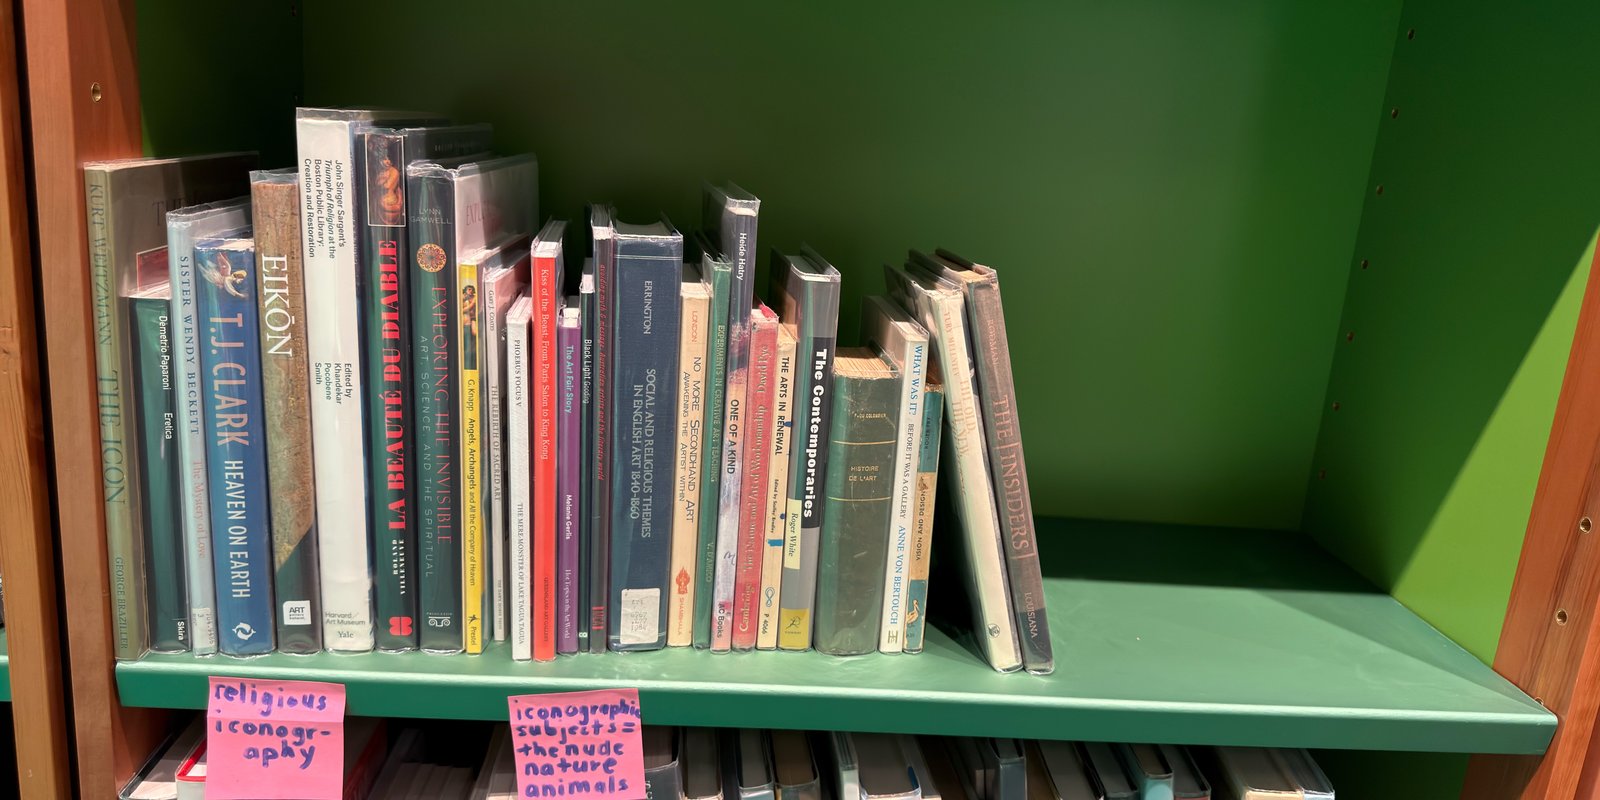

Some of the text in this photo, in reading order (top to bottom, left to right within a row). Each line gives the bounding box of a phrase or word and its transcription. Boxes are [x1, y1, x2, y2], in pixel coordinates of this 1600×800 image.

[304, 158, 317, 259] Creation and Restoration
[314, 159, 326, 248] Boston Public Library:
[324, 160, 337, 259] Triumph Religion the
[335, 160, 347, 248] John Singer Sargent's
[89, 183, 113, 346] KURT WEITZMANN
[736, 232, 748, 281] Heide Hatry
[261, 252, 295, 357] EIKŌN
[643, 280, 653, 335] ERRINGTON
[690, 310, 699, 343] LONDON
[158, 315, 173, 391] Demetrio Paparoni
[179, 255, 200, 435] SISTER WENDY BECKETT
[540, 268, 551, 461] Kiss the Beast: From Paris Salon King Kong
[693, 356, 702, 373] NO
[986, 319, 1000, 366] RODMAN
[209, 312, 250, 447] T.J. CLARK
[315, 362, 323, 385] Smith
[324, 362, 334, 401] Pocobene
[334, 362, 344, 405] Khandekar
[344, 363, 353, 399] Edited by
[378, 240, 406, 531] LA BEAUTÉ DU DIABLE
[514, 339, 523, 398] PHOEBUS FOCUS
[564, 344, 575, 414] The Art Fair Story
[582, 338, 593, 405] Black Light Gooding
[755, 345, 772, 394] David Pye
[908, 345, 925, 416] WHAT WAS IT?
[431, 286, 452, 545] EXPLORING THE INVISIBLE
[466, 388, 476, 412] Knapp
[692, 380, 701, 412] MORE
[711, 325, 726, 482] EXPERIMENTS CREATIVE TEACHING
[775, 356, 790, 456] THE ARTS IN RENEWAL
[98, 370, 126, 505] THE ICON
[164, 412, 175, 440] Eretica
[681, 420, 689, 438] THE
[726, 399, 740, 475] ONE OF A KIND
[803, 348, 829, 518] The Contemporaries
[492, 403, 502, 502] REBIRTH SACRED ART
[629, 384, 644, 520] IN ENGLISH ART 1840-1860
[641, 368, 656, 539] SOCIAL AND RELIGIOUS THEMES
[679, 442, 688, 471] ARTIST
[899, 423, 915, 519] BEFORE WAS GALLERY
[991, 394, 1030, 553] THE INSIDERS
[193, 482, 206, 520] Mystery
[423, 444, 434, 578] AND THE SPIRITUAL
[466, 417, 478, 587] Angels, Archangels and Company Heaven
[678, 474, 687, 503] WITHIN
[685, 499, 696, 524] ART
[224, 460, 251, 598] HEAVEN ON EARTH
[565, 494, 573, 541] Melanie Gerlis
[787, 512, 800, 557] Roger White
[914, 490, 926, 561] VISION AND DESIGN
[114, 556, 126, 596] GEORGE
[890, 525, 907, 625] ANNE VON BERTOUCH
[177, 621, 186, 641] Skira
[338, 631, 354, 639] Yale
[518, 600, 526, 622] TAGUA
[518, 623, 526, 645] TAGUA
[677, 596, 685, 637] SHAMBHALA
[716, 603, 726, 639] AC Books
[1024, 592, 1040, 639] LOUISIANA
[215, 682, 327, 717] religious
[514, 699, 641, 725] iconographic
[215, 709, 331, 746] iconogr-
[516, 740, 624, 758] the nude
[243, 740, 316, 770] aphy
[525, 757, 618, 776] nature
[525, 775, 629, 798] animals
